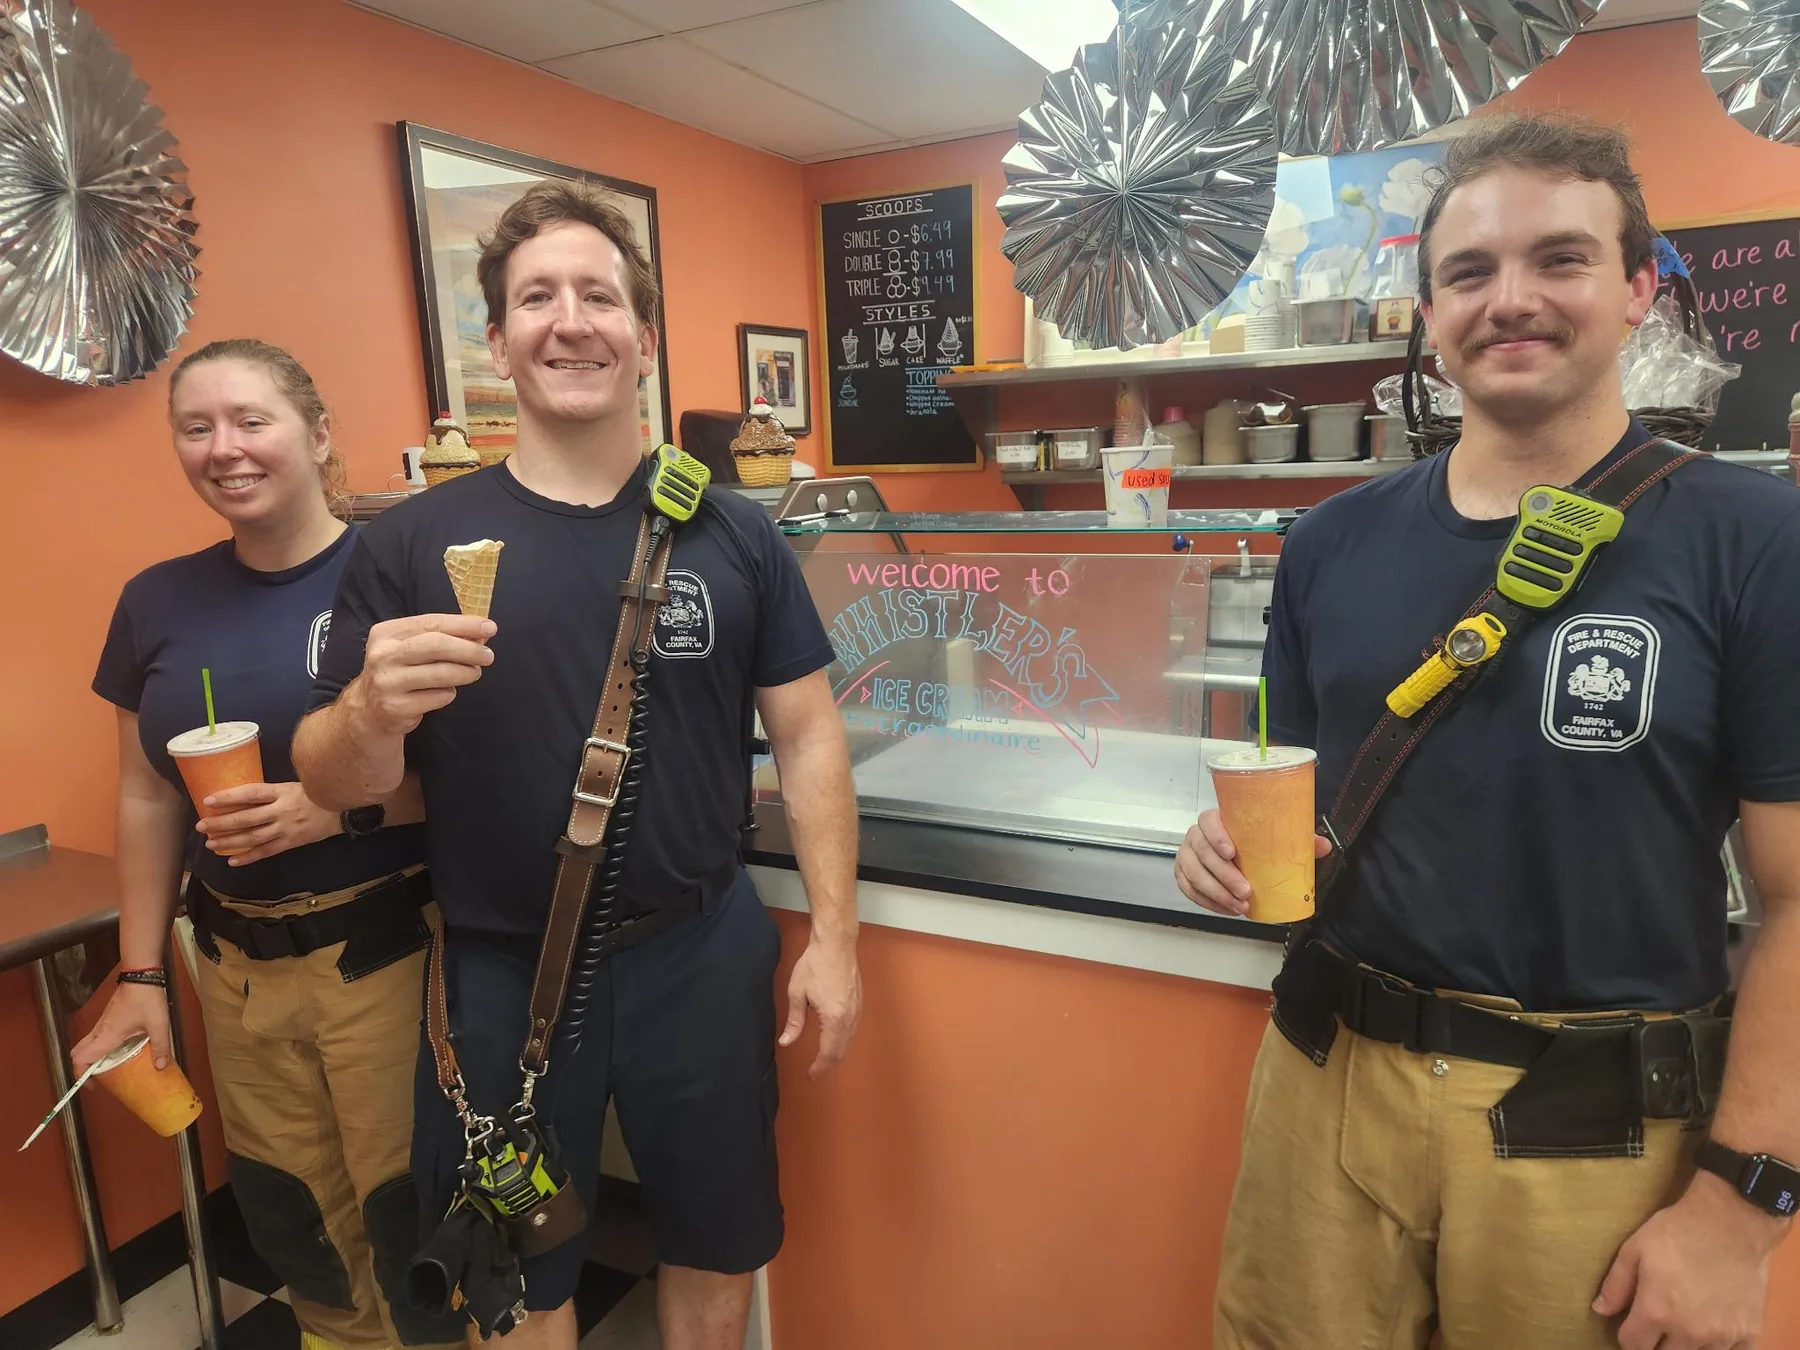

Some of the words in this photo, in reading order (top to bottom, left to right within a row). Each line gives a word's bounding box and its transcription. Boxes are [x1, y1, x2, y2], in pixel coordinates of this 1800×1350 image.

[865, 198, 923, 217] SCOOPS
[843, 229, 881, 249] SINGLE
[844, 253, 882, 273] DOUBLE
[1712, 245, 1762, 270] are
[845, 277, 882, 297] TRIPLE
[1699, 281, 1788, 313] we're
[866, 304, 931, 321] STYLES
[878, 357, 900, 367] SUGAR
[906, 356, 924, 364] CAKE
[1127, 472, 1156, 487] used
[1535, 518, 1582, 538] MOTOROLA
[668, 579, 699, 591] RESCUE
[846, 562, 1000, 592] welcome
[1025, 567, 1070, 595] to
[1566, 629, 1590, 644] FIRE
[1592, 628, 1600, 638] &
[1603, 629, 1644, 650] RESCUE
[1567, 638, 1641, 659] DEPARTMENT
[871, 677, 912, 713] ICE
[1583, 702, 1604, 711] 1742
[1561, 724, 1607, 738] COUNTY,
[1610, 729, 1623, 738] VA
[1572, 715, 1615, 728] FAIRFAX
